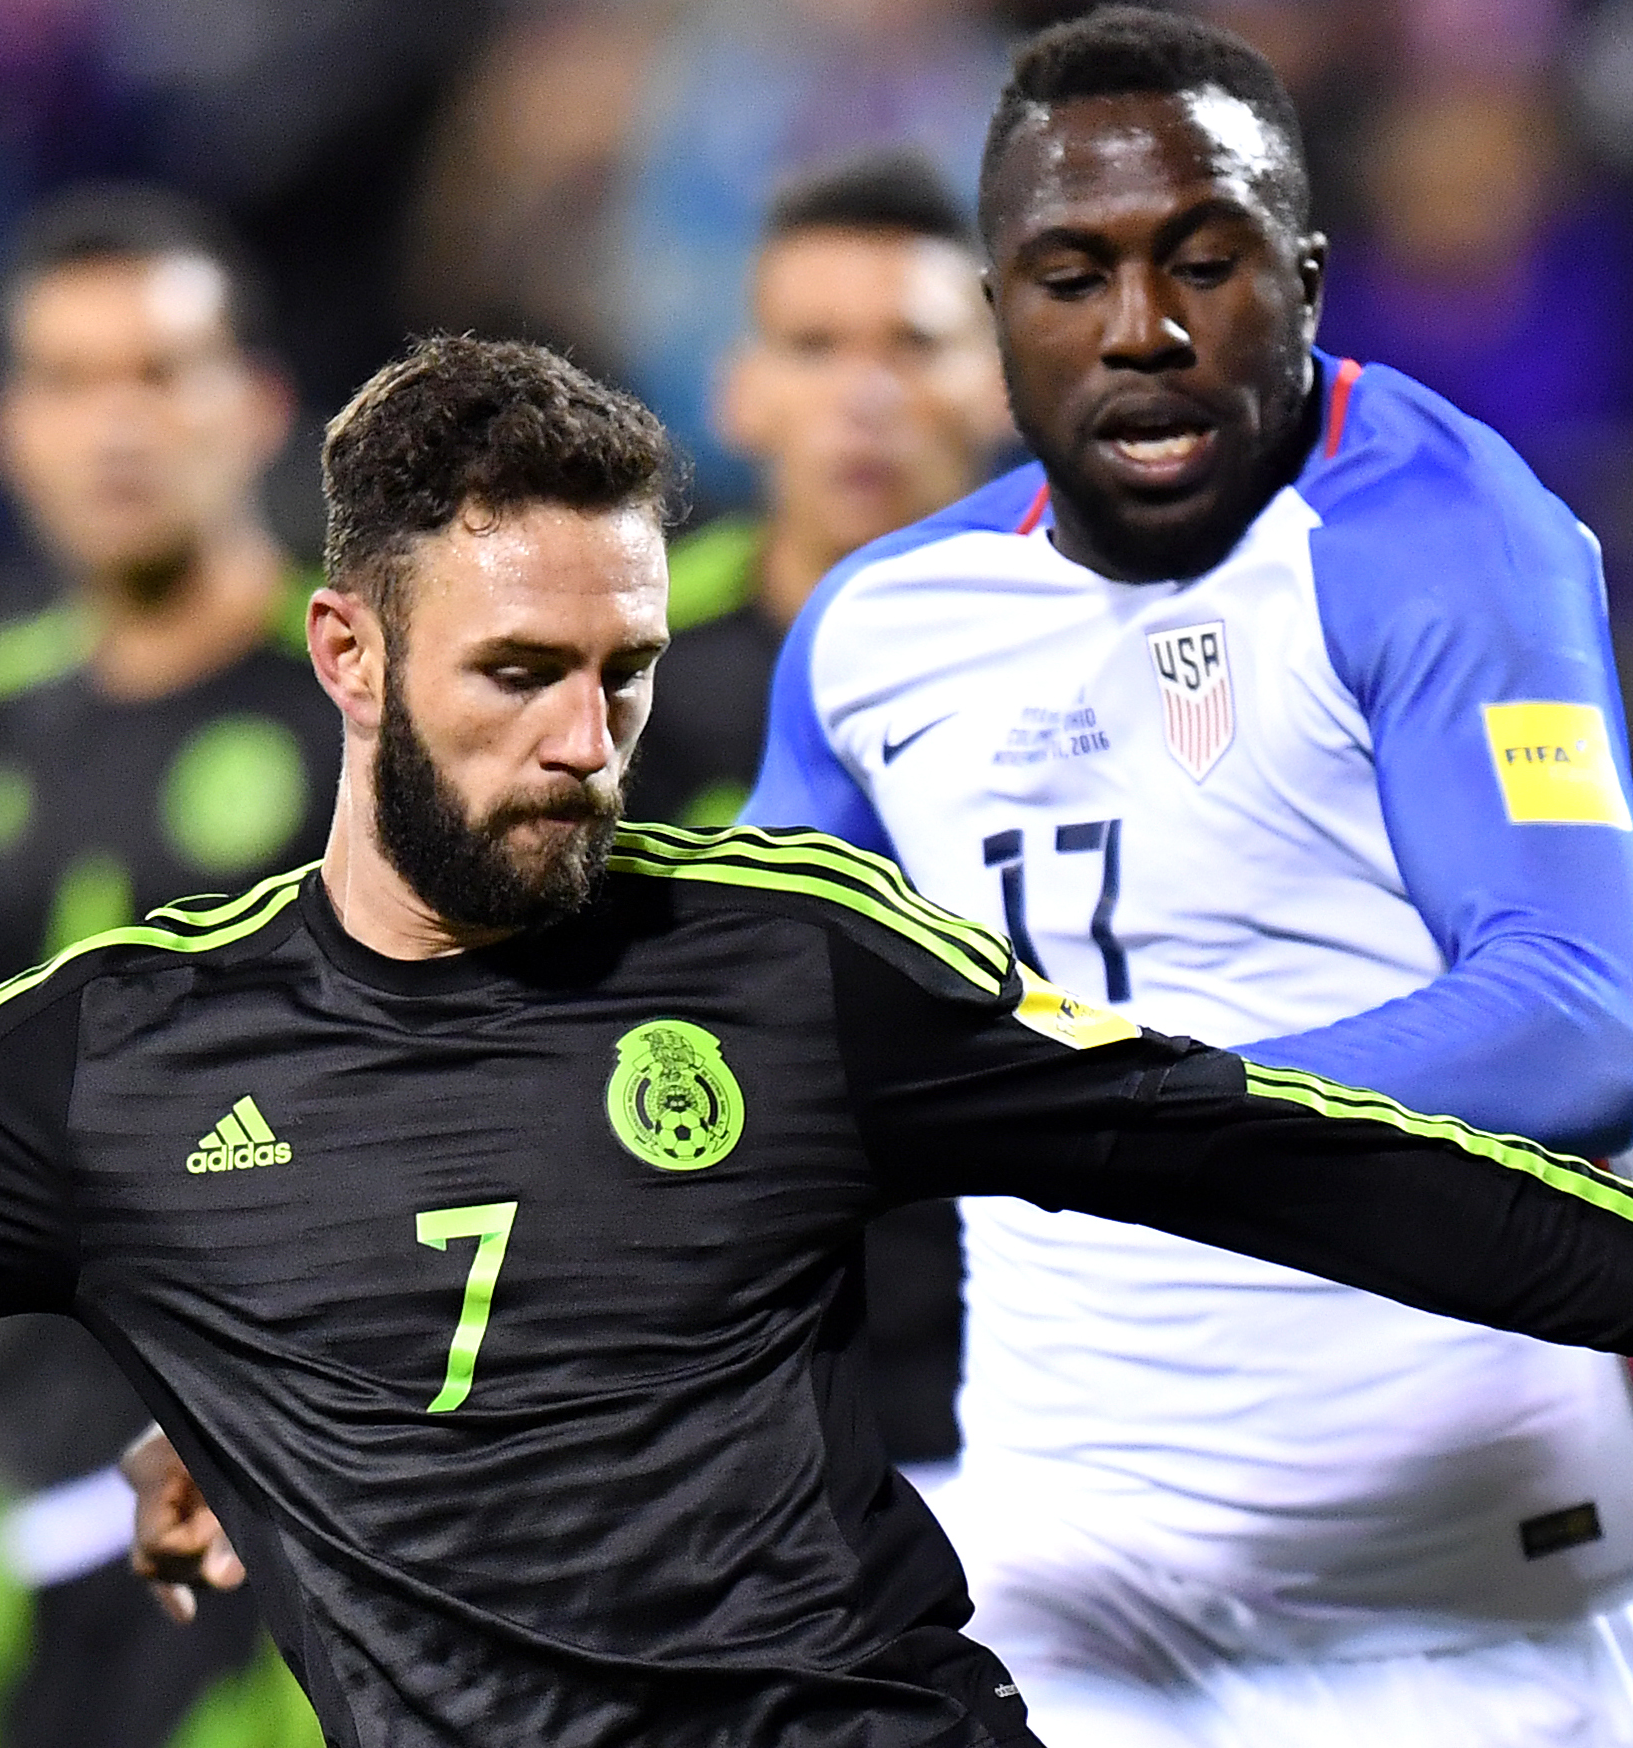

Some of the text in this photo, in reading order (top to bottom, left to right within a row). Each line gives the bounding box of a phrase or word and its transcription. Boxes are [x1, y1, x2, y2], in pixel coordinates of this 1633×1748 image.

[1154, 632, 1220, 691] USA
[1070, 731, 1110, 756] 2016
[1505, 746, 1571, 766] FIFA
[983, 818, 1132, 1004] 17
[186, 1142, 293, 1174] adidas
[416, 1201, 518, 1413] 7
